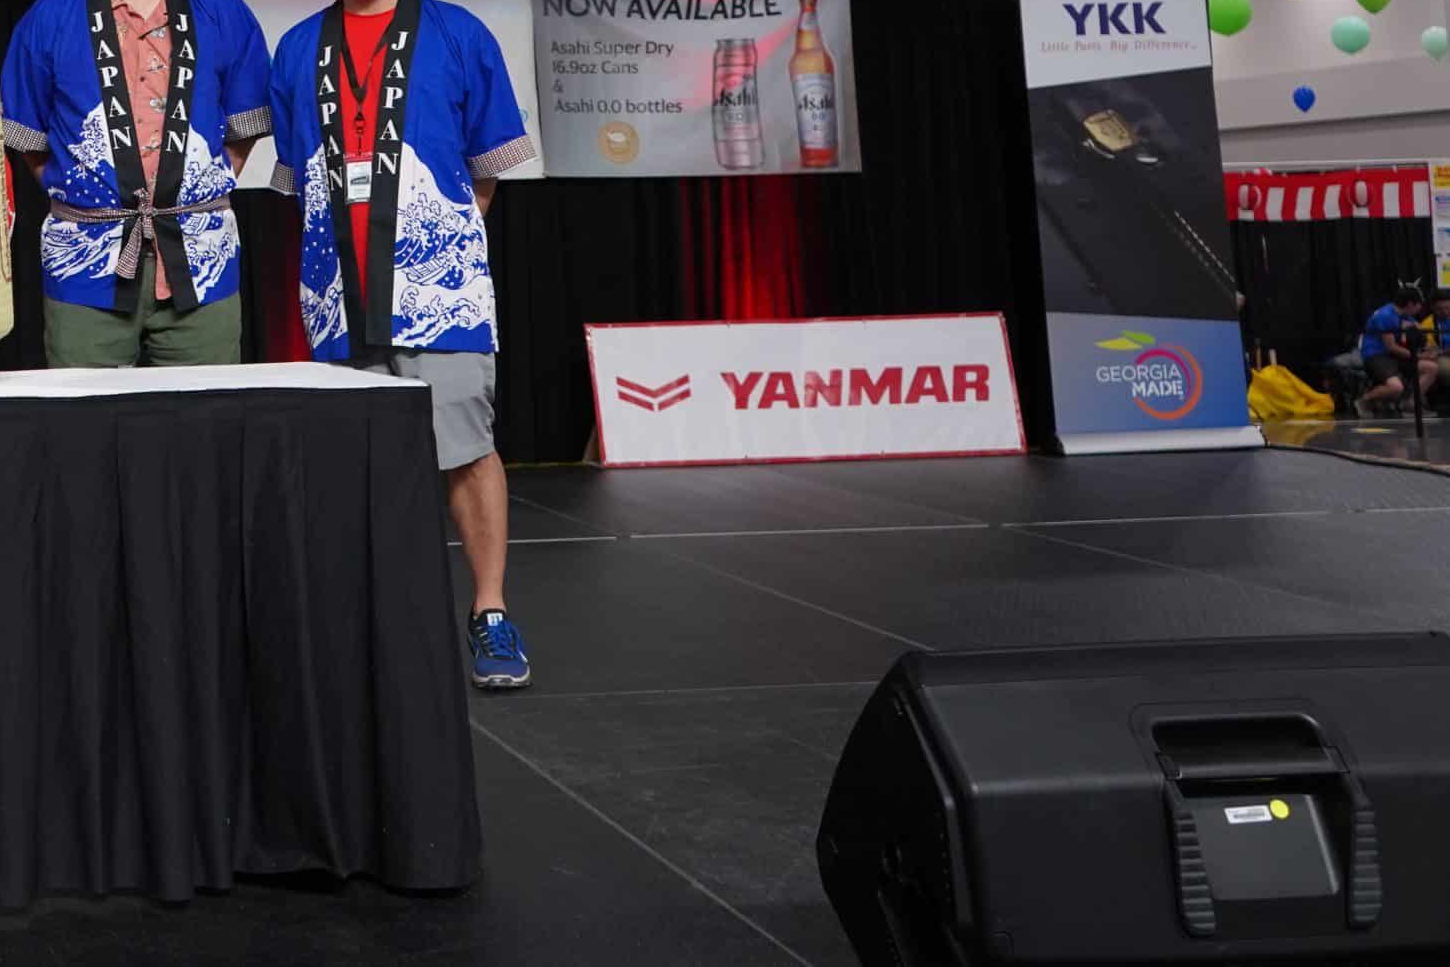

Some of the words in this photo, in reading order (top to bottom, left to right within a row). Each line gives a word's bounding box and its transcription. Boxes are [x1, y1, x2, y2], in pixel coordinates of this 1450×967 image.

[1061, 1, 1167, 36] YKK
[551, 41, 591, 56] Asahi
[594, 41, 641, 59] Super
[645, 41, 674, 58] Dry
[91, 10, 132, 150] JAPAN
[601, 60, 639, 75] Cans
[165, 13, 195, 154] JAPAN
[553, 80, 564, 94] &
[377, 31, 410, 175] JAPAN
[554, 99, 595, 114] Asahi
[626, 99, 683, 114] bottles
[318, 45, 343, 192] JAPAN
[719, 363, 990, 410] YANMAR
[1095, 363, 1182, 383] GEORGIA
[1132, 380, 1184, 398] MADE
